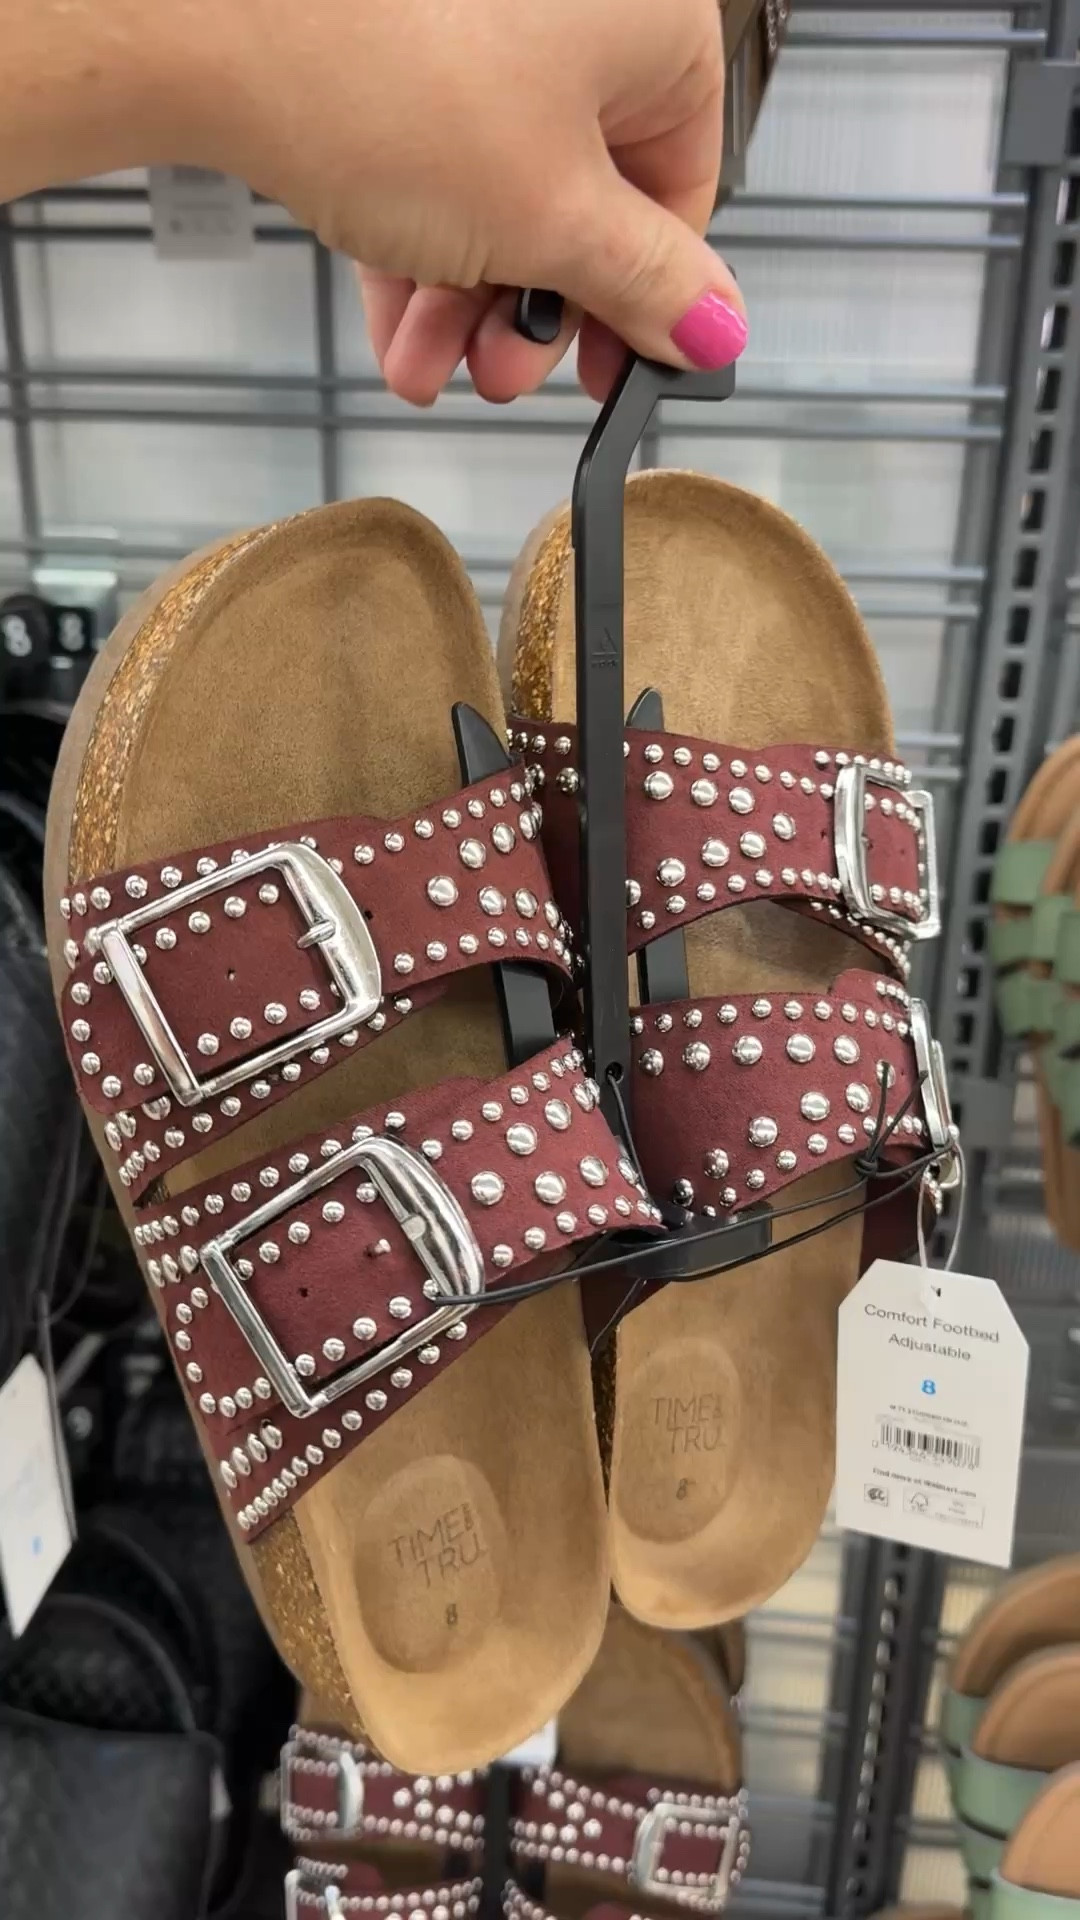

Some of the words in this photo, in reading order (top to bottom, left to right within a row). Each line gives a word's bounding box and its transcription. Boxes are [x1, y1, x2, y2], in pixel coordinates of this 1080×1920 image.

[864, 1303, 928, 1328] Comfort
[933, 1318, 1000, 1343] Footbed
[888, 1333, 971, 1360] Adjustable
[921, 1380, 936, 1395] 8
[650, 1392, 714, 1425] TIME
[667, 1425, 722, 1454] TRU
[387, 1508, 464, 1569] TIME
[416, 1531, 480, 1589] TRU
